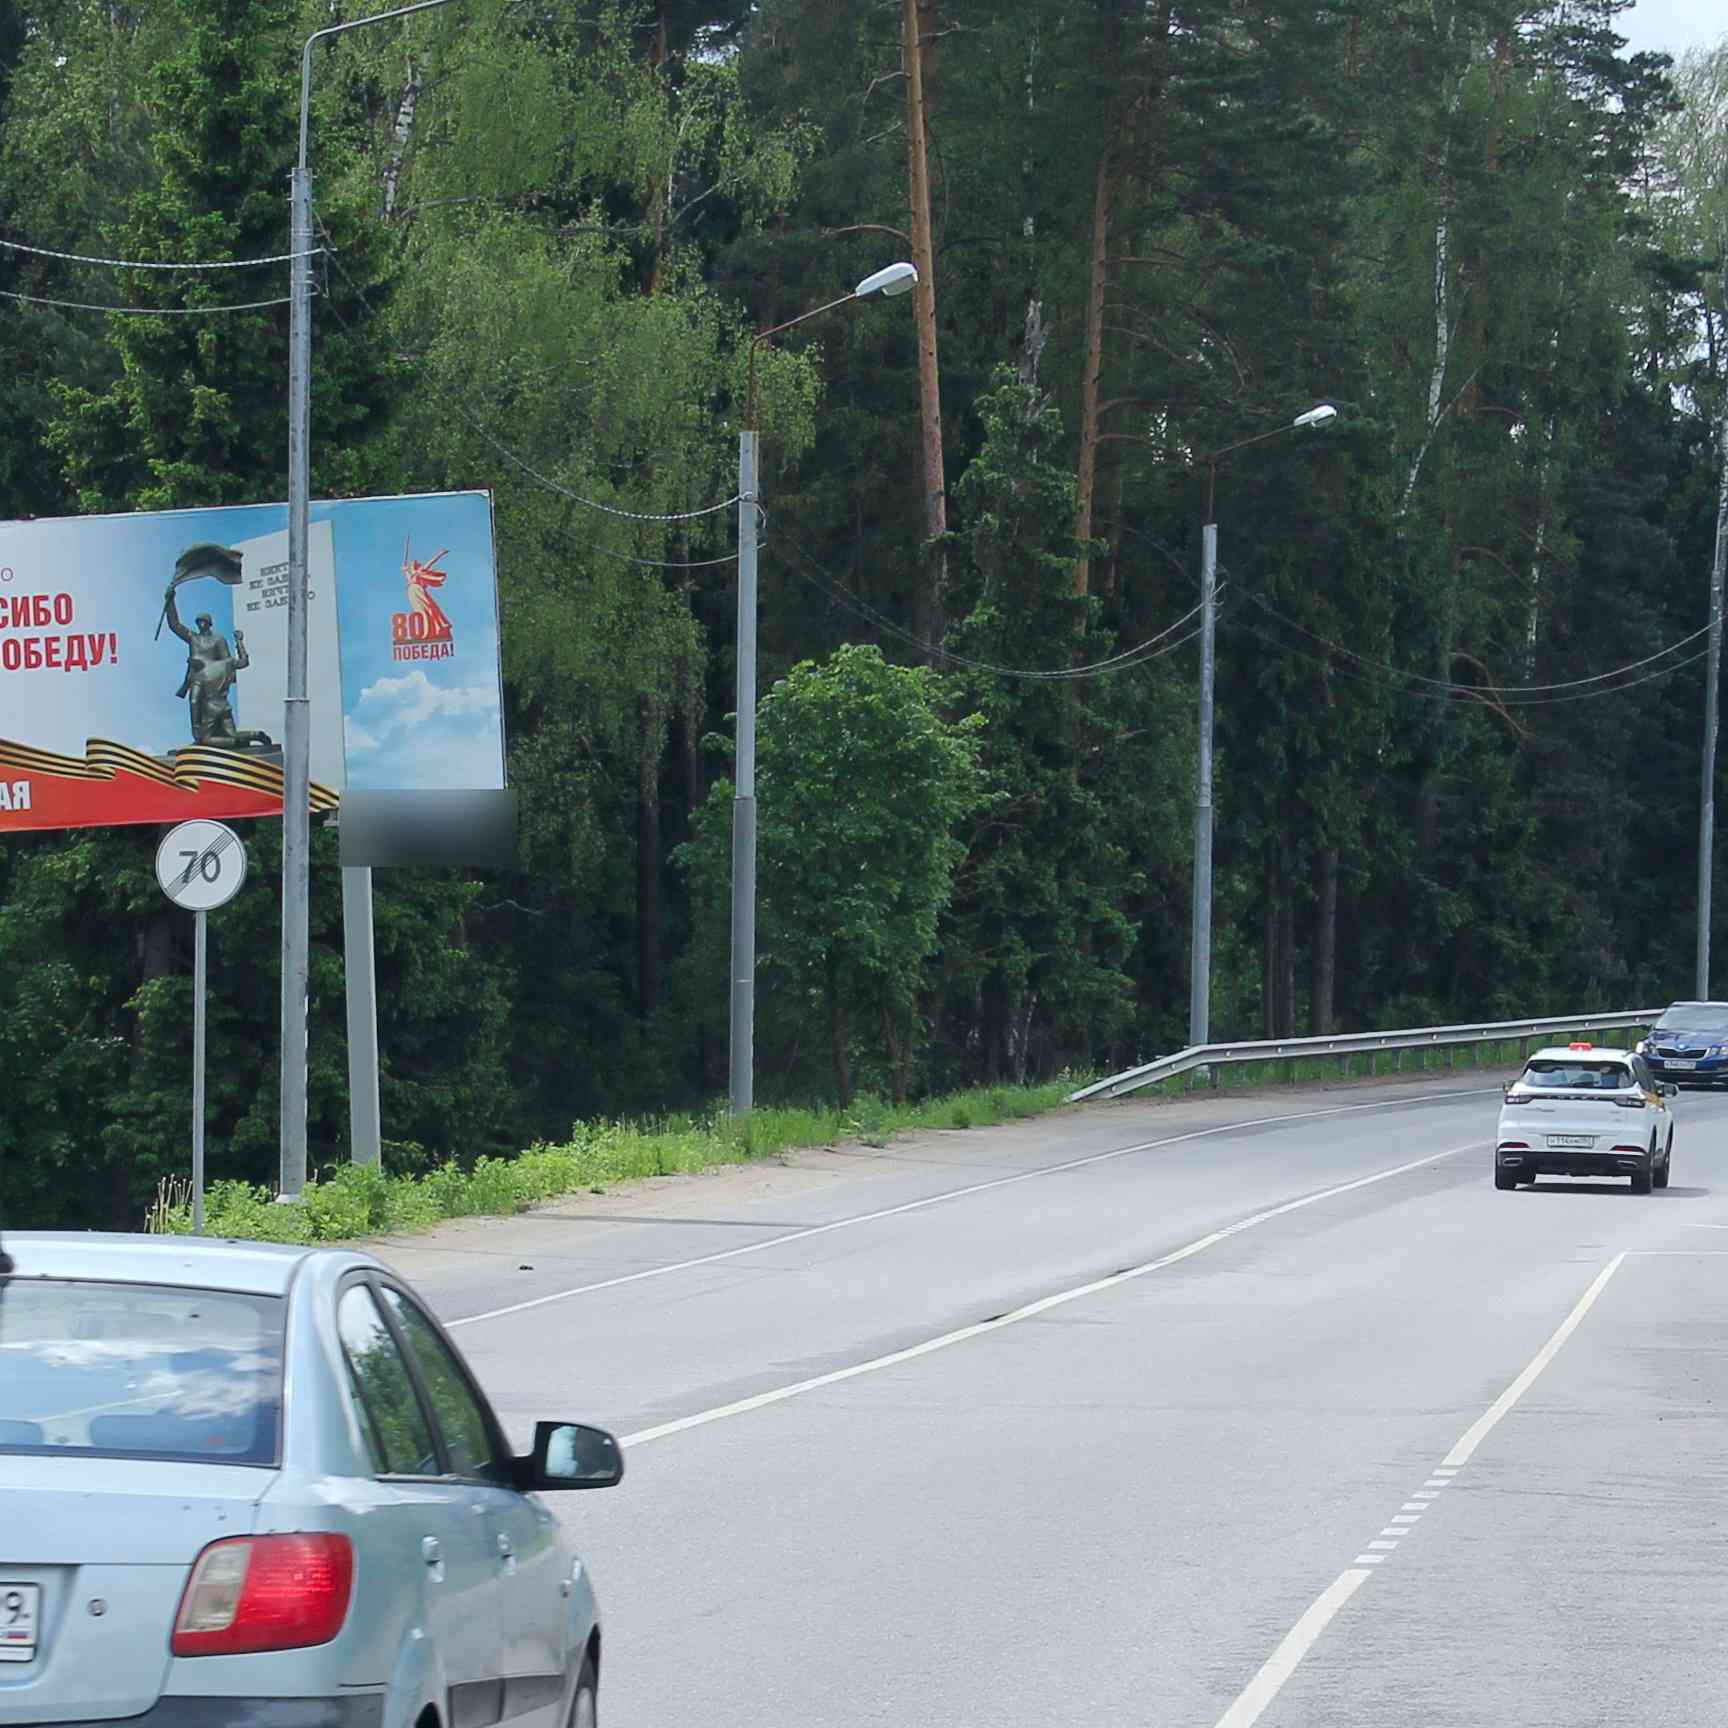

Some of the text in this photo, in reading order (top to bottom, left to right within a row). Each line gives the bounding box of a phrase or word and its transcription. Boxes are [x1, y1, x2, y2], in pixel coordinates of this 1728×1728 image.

[393, 612, 425, 640] 80
[393, 643, 455, 661] ПОБЕДА!
[179, 850, 221, 883] 70
